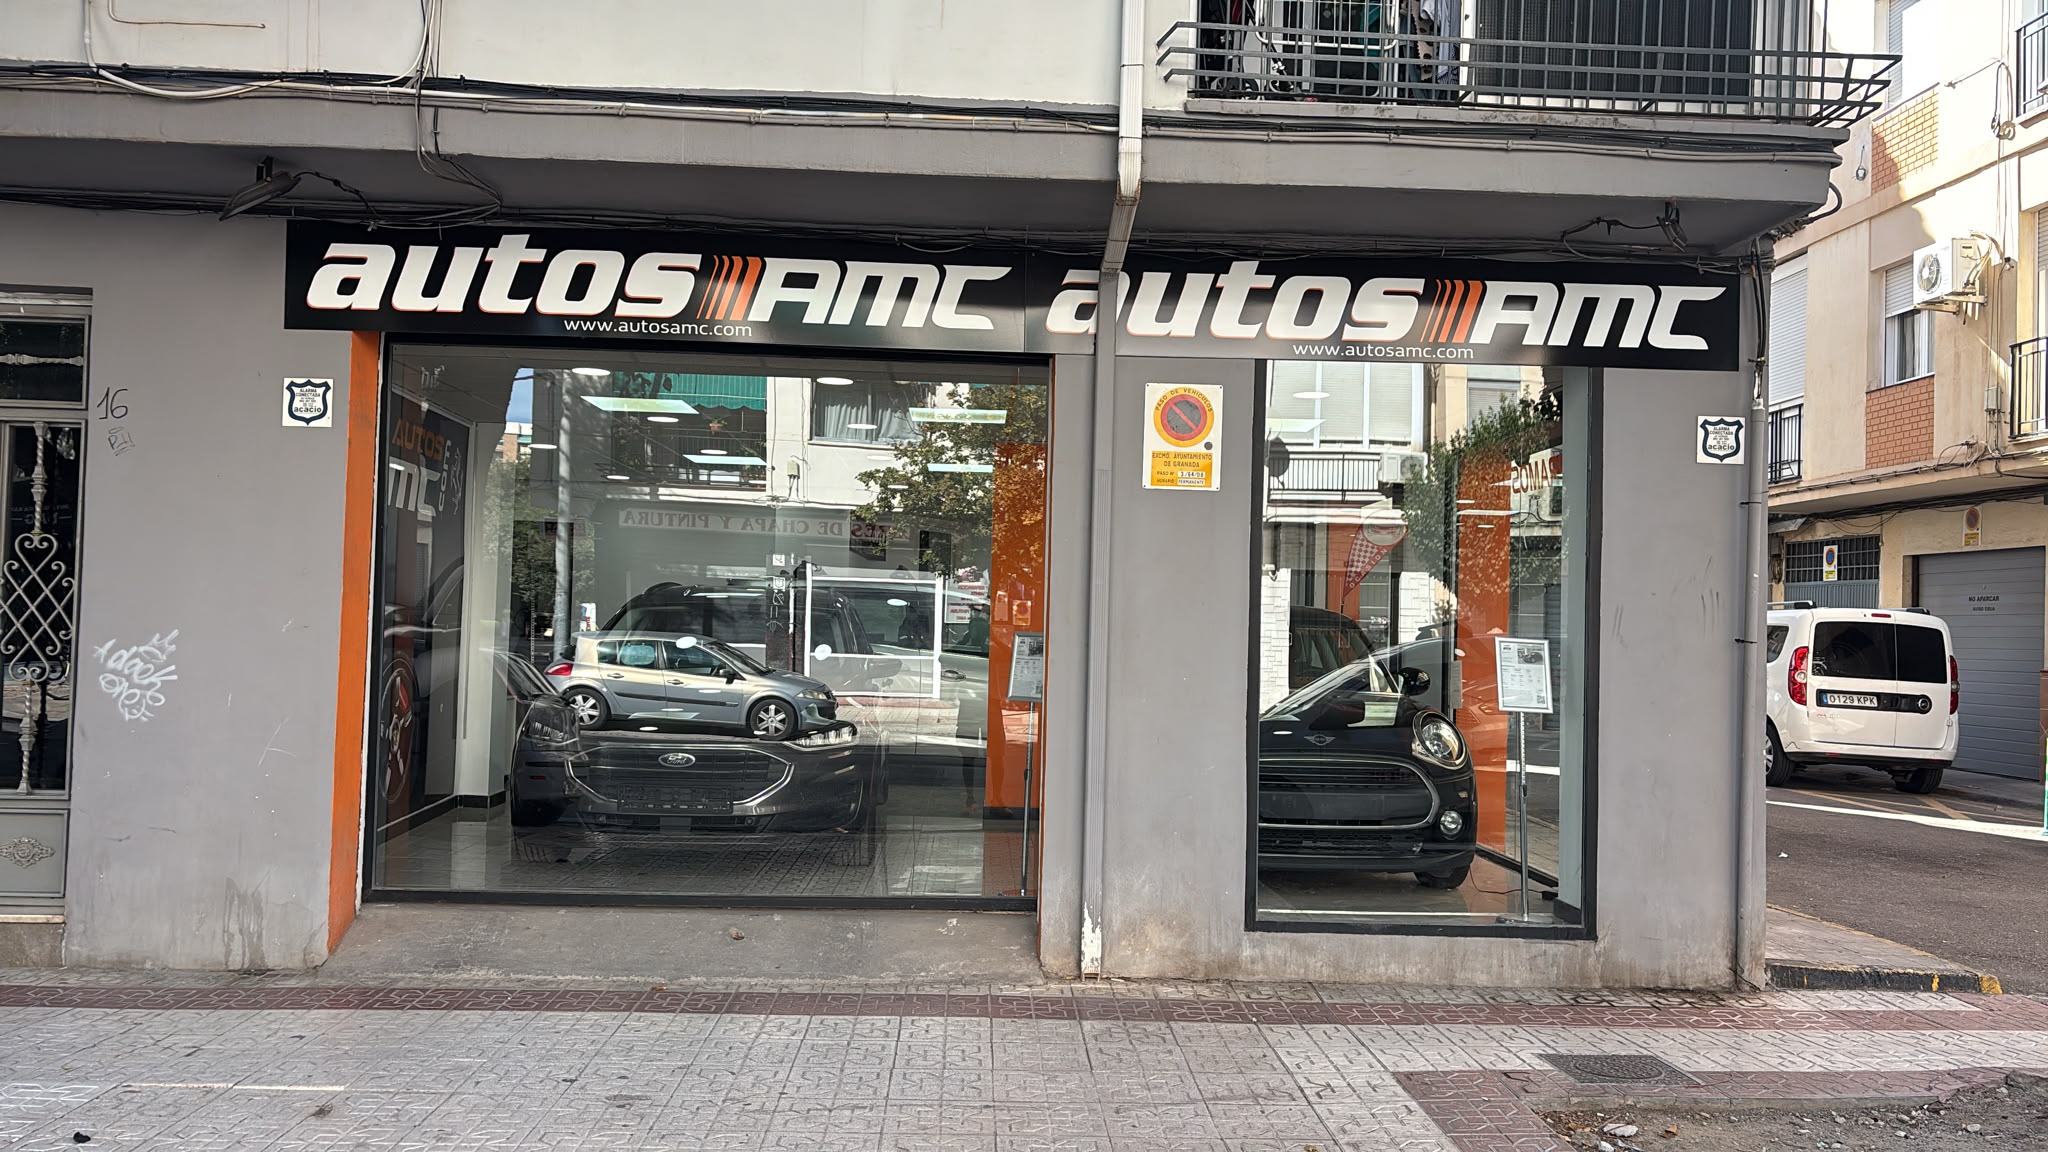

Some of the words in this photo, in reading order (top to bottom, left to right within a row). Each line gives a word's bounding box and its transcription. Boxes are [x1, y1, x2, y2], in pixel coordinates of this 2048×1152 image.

[306, 233, 702, 319] autos
[747, 257, 1013, 331] AMC
[1045, 260, 1426, 343] autos
[1469, 280, 1728, 351] AMC
[563, 318, 753, 338] www.autosamc.com
[1292, 342, 1474, 360] www.autosamc.com
[96, 386, 129, 420] 16
[293, 405, 322, 413] acacio
[391, 417, 445, 461] AUTOS
[1707, 443, 1735, 451] acacio
[1173, 452, 1213, 461] AYUNTAMIENTO
[1173, 460, 1200, 468] GRANADA
[1829, 694, 1855, 704] 0129
[1856, 695, 1876, 706] KPK
